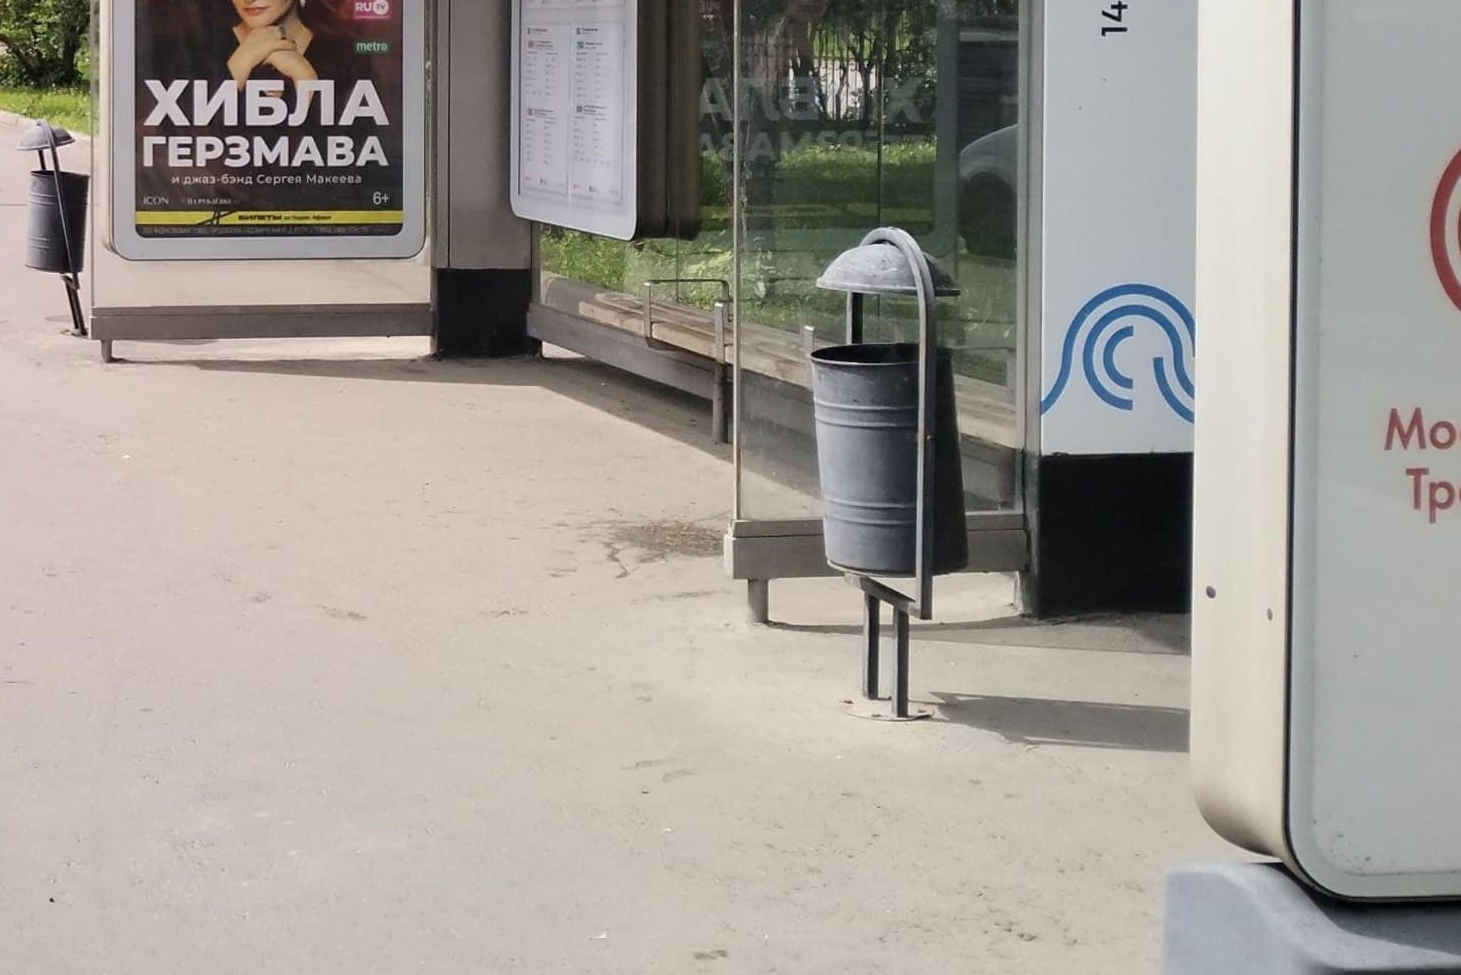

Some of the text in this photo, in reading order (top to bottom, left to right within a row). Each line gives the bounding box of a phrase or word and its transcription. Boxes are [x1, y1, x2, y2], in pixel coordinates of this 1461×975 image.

[356, 41, 389, 52] metro
[143, 79, 390, 126] ХИБЛА
[143, 135, 389, 167] ГЕРЗМАВА
[172, 174, 362, 186] и джаз-бэнд Сергея Макеева
[372, 191, 390, 205] 6+
[1384, 406, 1461, 451] Мо
[1405, 467, 1461, 524] Тр
